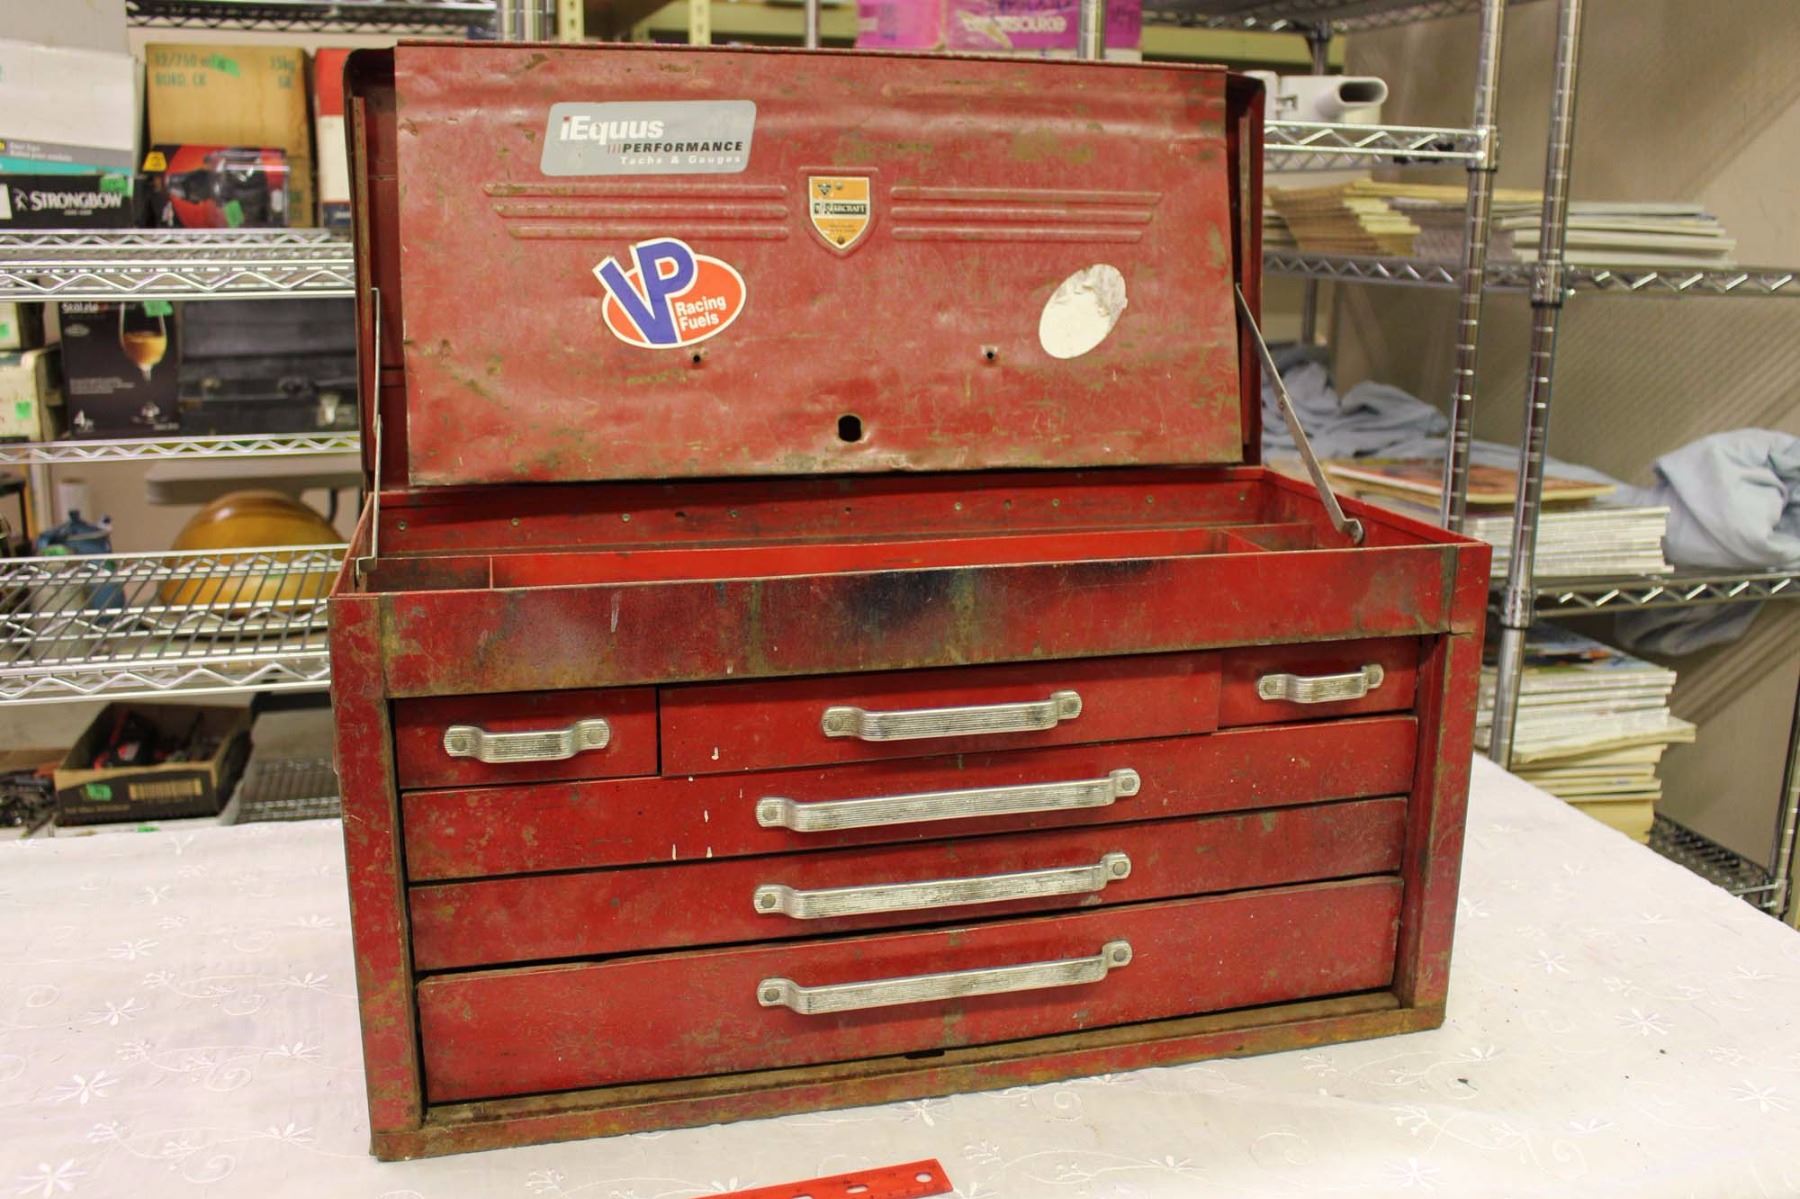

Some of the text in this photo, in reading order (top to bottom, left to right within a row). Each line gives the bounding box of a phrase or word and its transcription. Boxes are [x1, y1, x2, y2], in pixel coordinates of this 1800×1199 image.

[622, 141, 744, 154] PERFORMANCE
[620, 154, 742, 166] Tachs & Gauges
[29, 190, 123, 212] STRONGBOW
[596, 239, 697, 345] VP
[675, 295, 727, 317] Racing
[679, 312, 720, 332] Fuels
